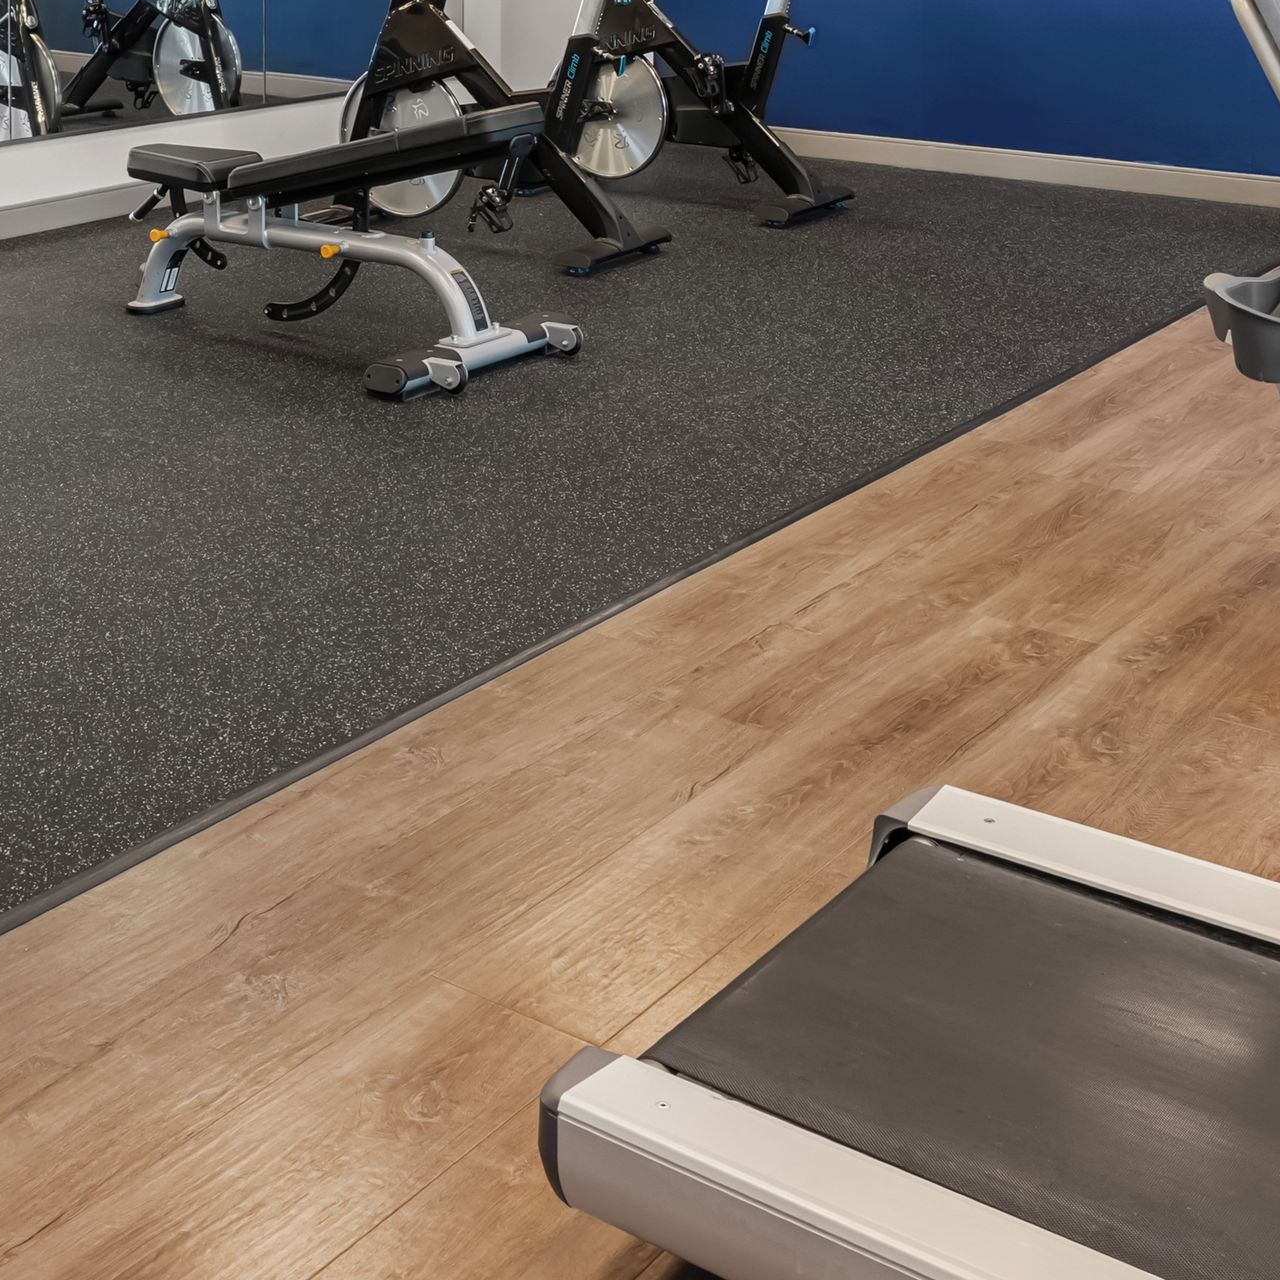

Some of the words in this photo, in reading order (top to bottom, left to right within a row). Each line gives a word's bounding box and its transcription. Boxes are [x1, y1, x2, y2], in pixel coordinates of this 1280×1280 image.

[760, 29, 774, 55] Climb
[374, 45, 455, 85] SPINNING
[555, 81, 573, 122] SPINNER
[566, 53, 581, 80] Climb
